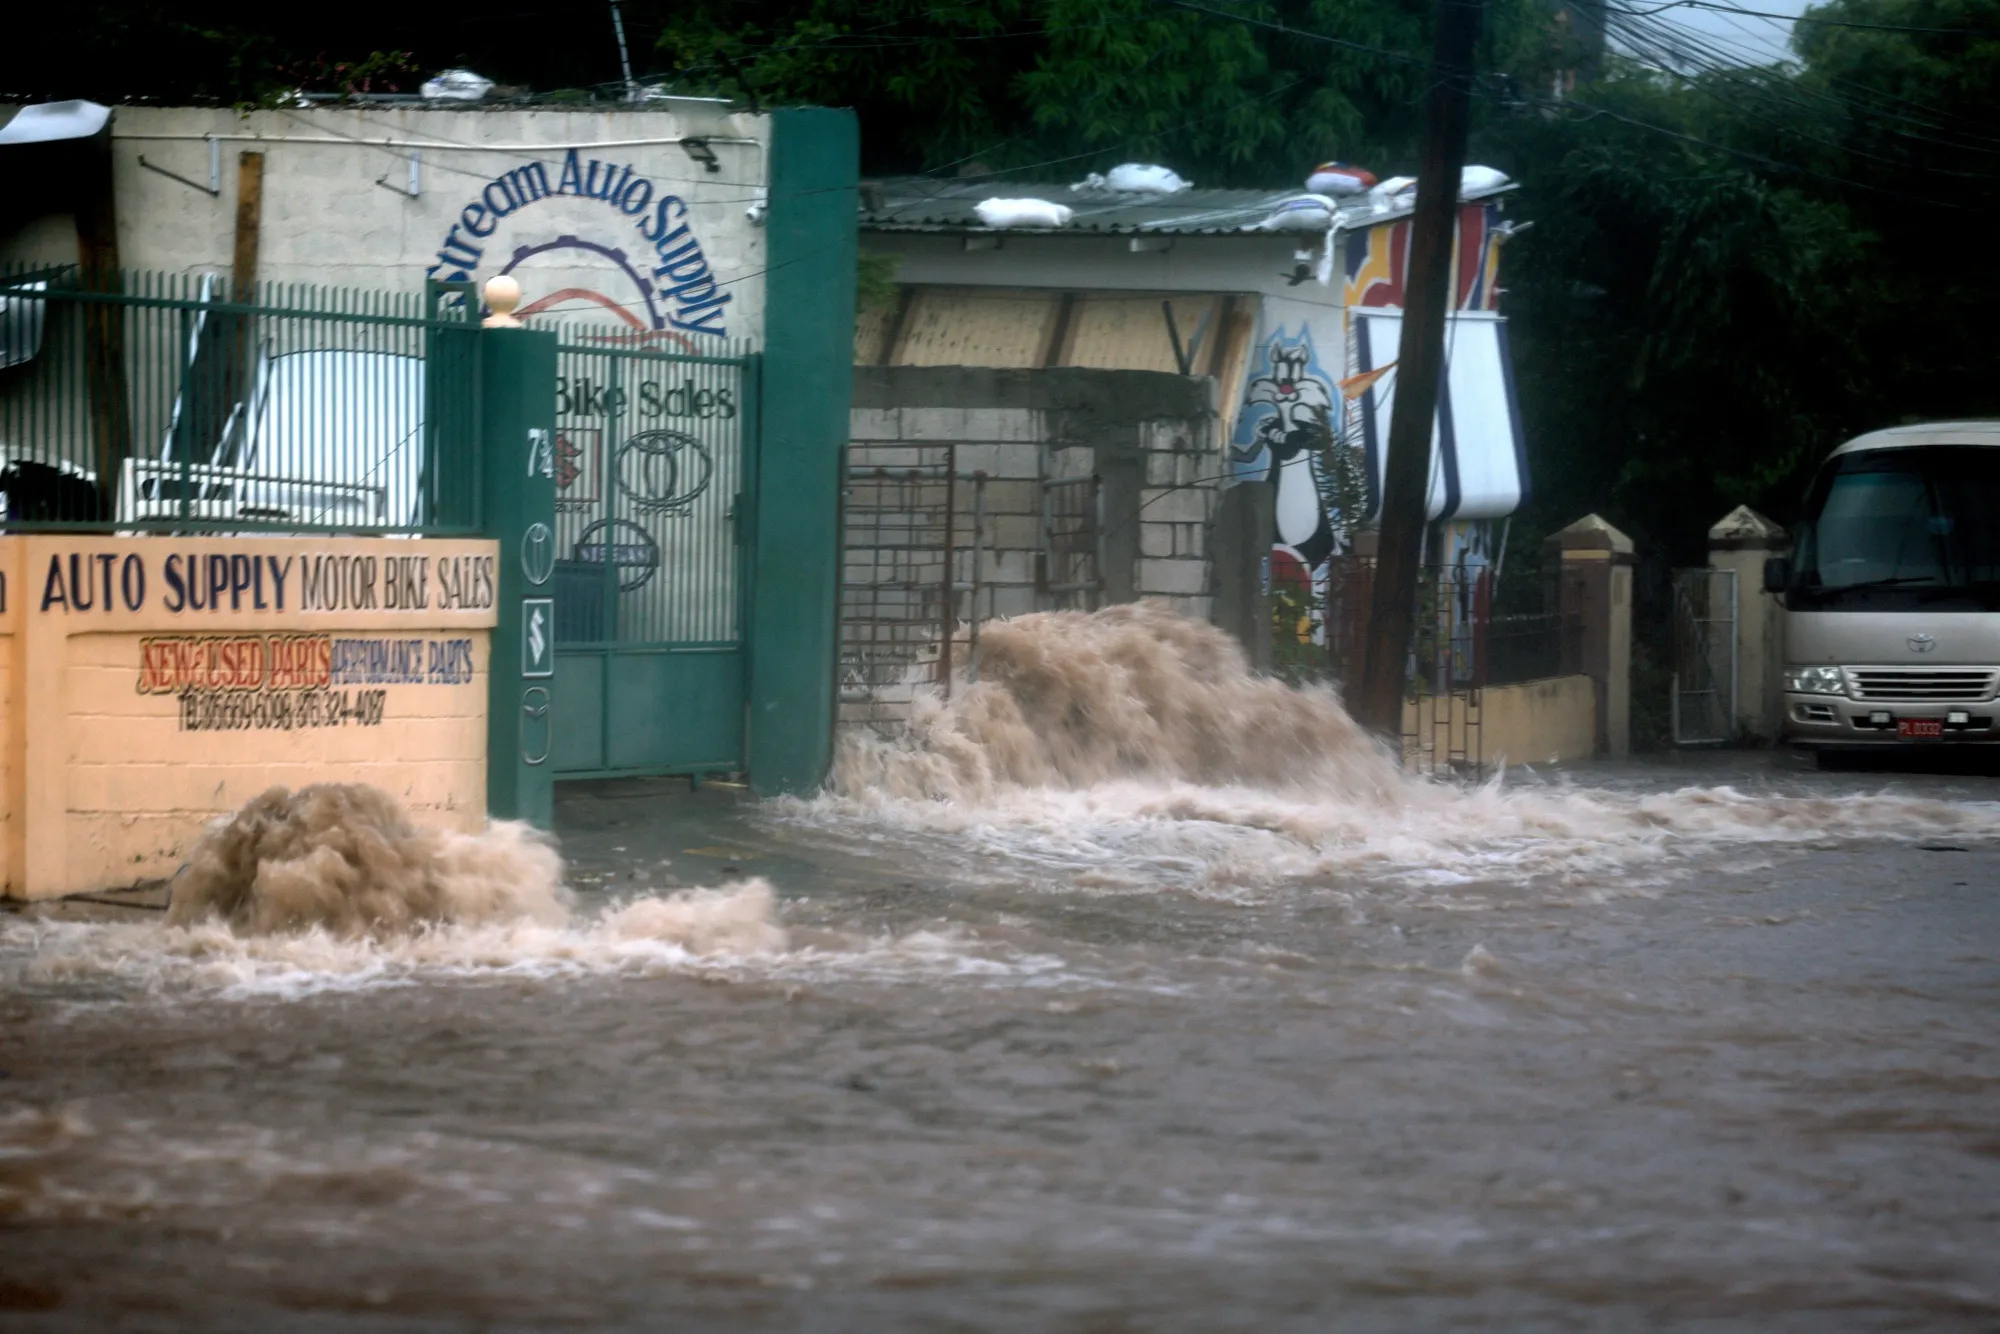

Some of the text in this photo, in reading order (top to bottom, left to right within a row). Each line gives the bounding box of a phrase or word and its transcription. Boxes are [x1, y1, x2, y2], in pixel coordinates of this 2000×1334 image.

[560, 148, 655, 216] Auto
[637, 195, 733, 339] Supply
[639, 379, 736, 420] Sales
[40, 553, 146, 614] AUTO
[163, 553, 293, 614] SUPPLY
[299, 554, 378, 612] MOTOR
[383, 555, 431, 611] BIKE
[437, 555, 494, 611] SALES
[269, 638, 331, 686] PARTS
[428, 638, 473, 685] PARTS
